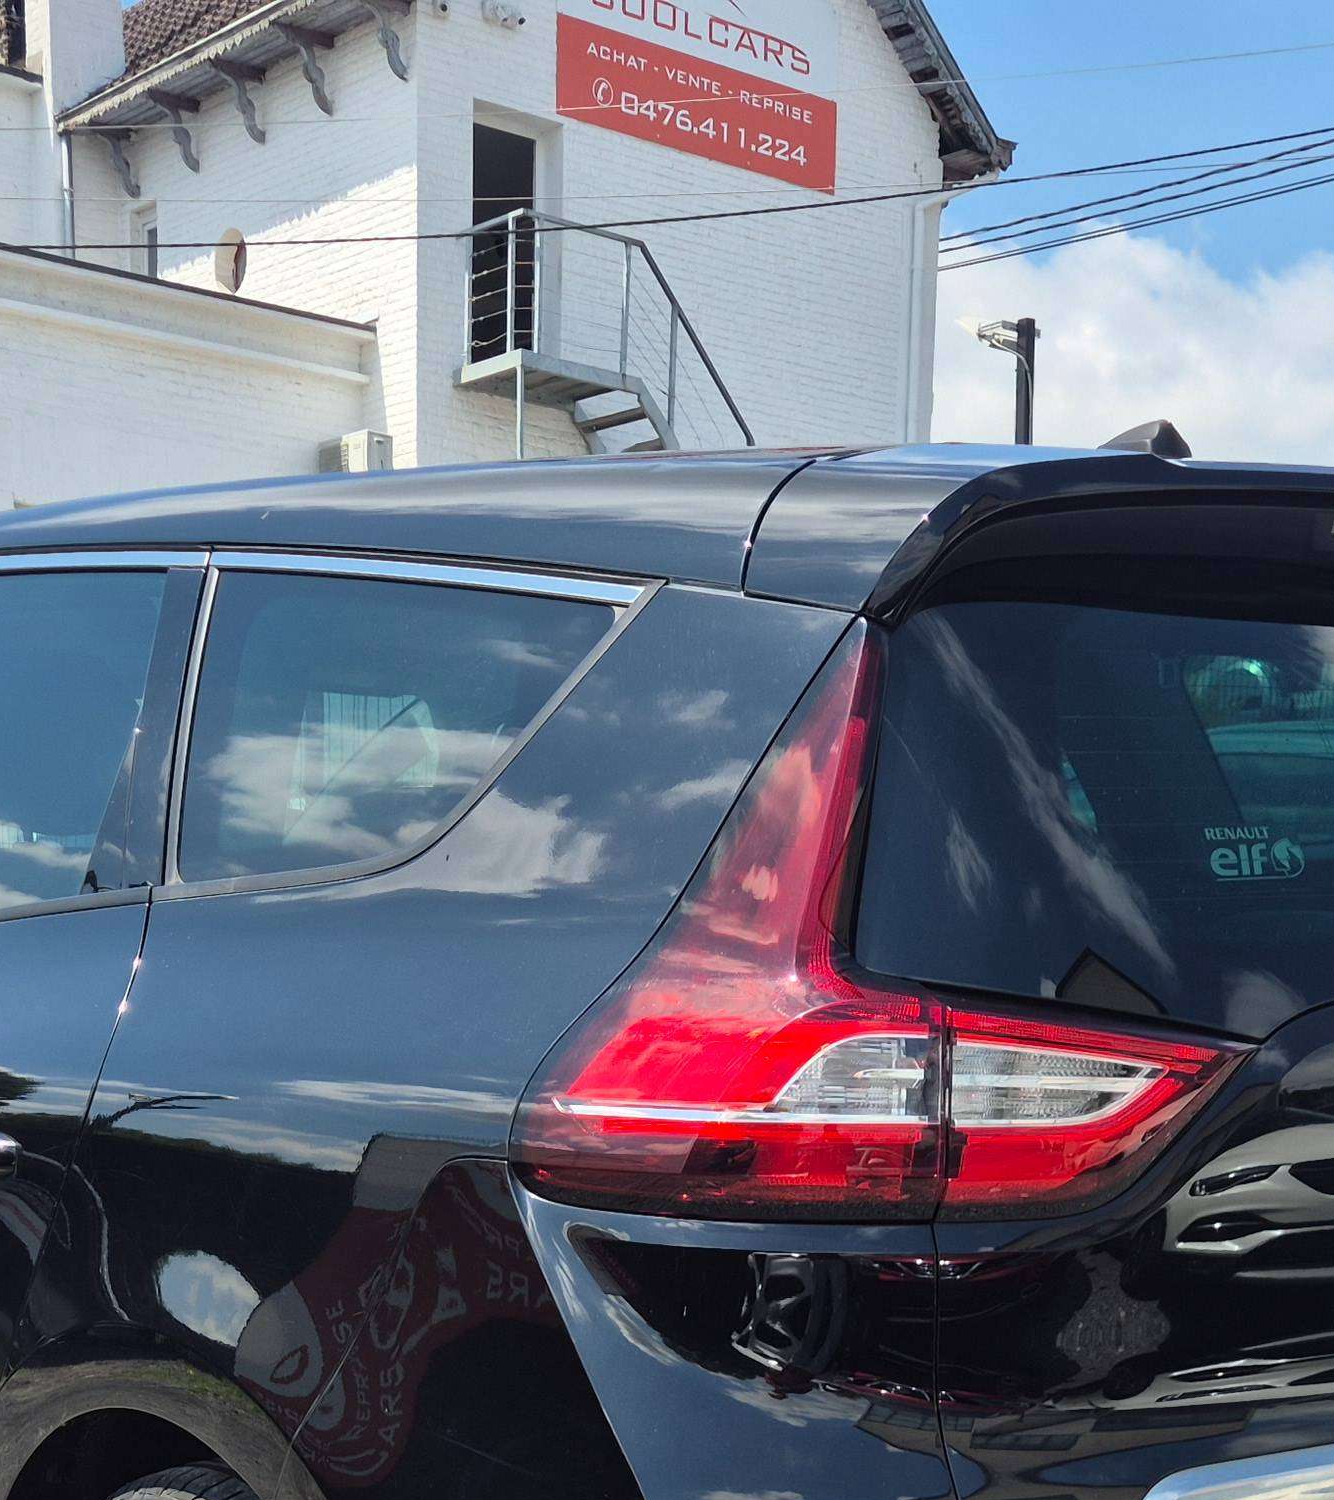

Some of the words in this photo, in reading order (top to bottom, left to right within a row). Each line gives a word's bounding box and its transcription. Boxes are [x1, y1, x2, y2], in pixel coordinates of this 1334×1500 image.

[586, 41, 648, 72] ACHAT
[665, 65, 722, 96] VENTE
[739, 89, 814, 125] REPRISE
[620, 91, 808, 167] 0476.411.224
[1204, 826, 1269, 841] RENAULT
[1210, 842, 1269, 877] elf
